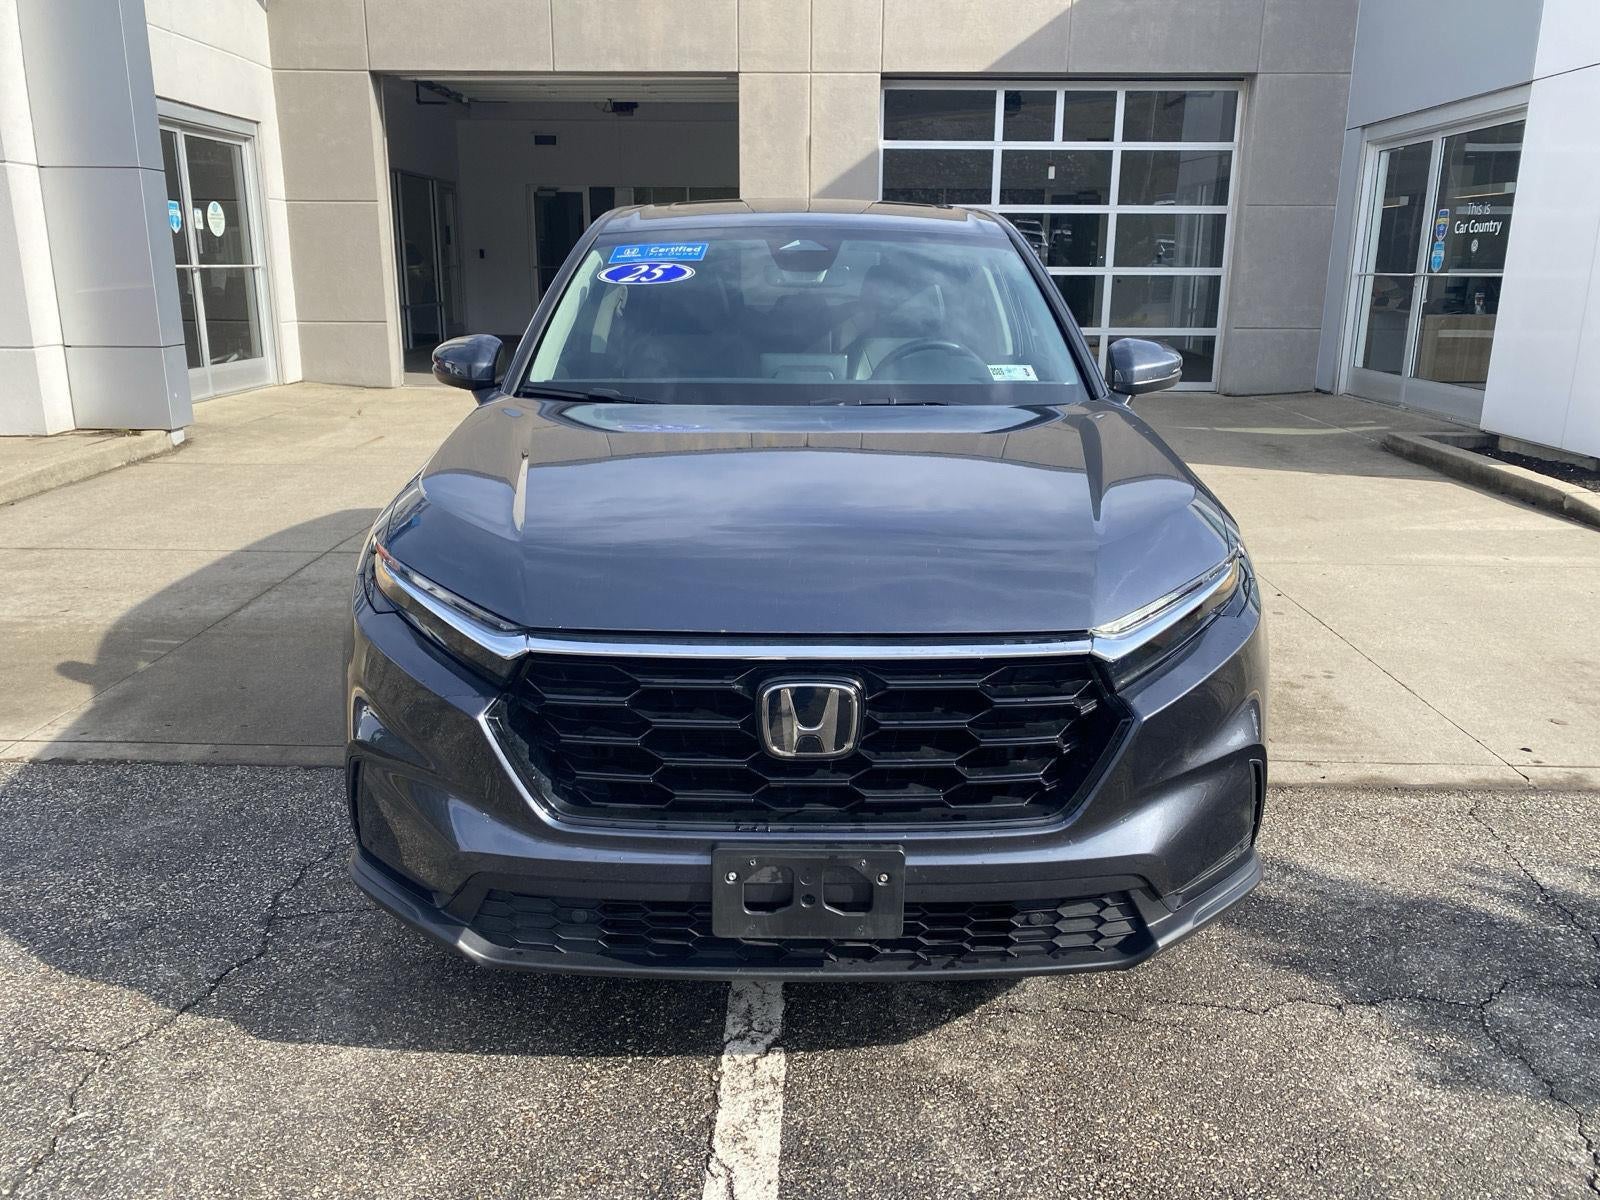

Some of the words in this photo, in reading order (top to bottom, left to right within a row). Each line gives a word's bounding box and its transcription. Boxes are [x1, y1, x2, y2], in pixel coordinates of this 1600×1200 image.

[1467, 202, 1482, 215] This
[1483, 201, 1491, 215] is
[1454, 221, 1468, 234] Car
[1468, 219, 1503, 236] Country
[650, 245, 702, 253] Certified
[617, 264, 674, 282] 25
